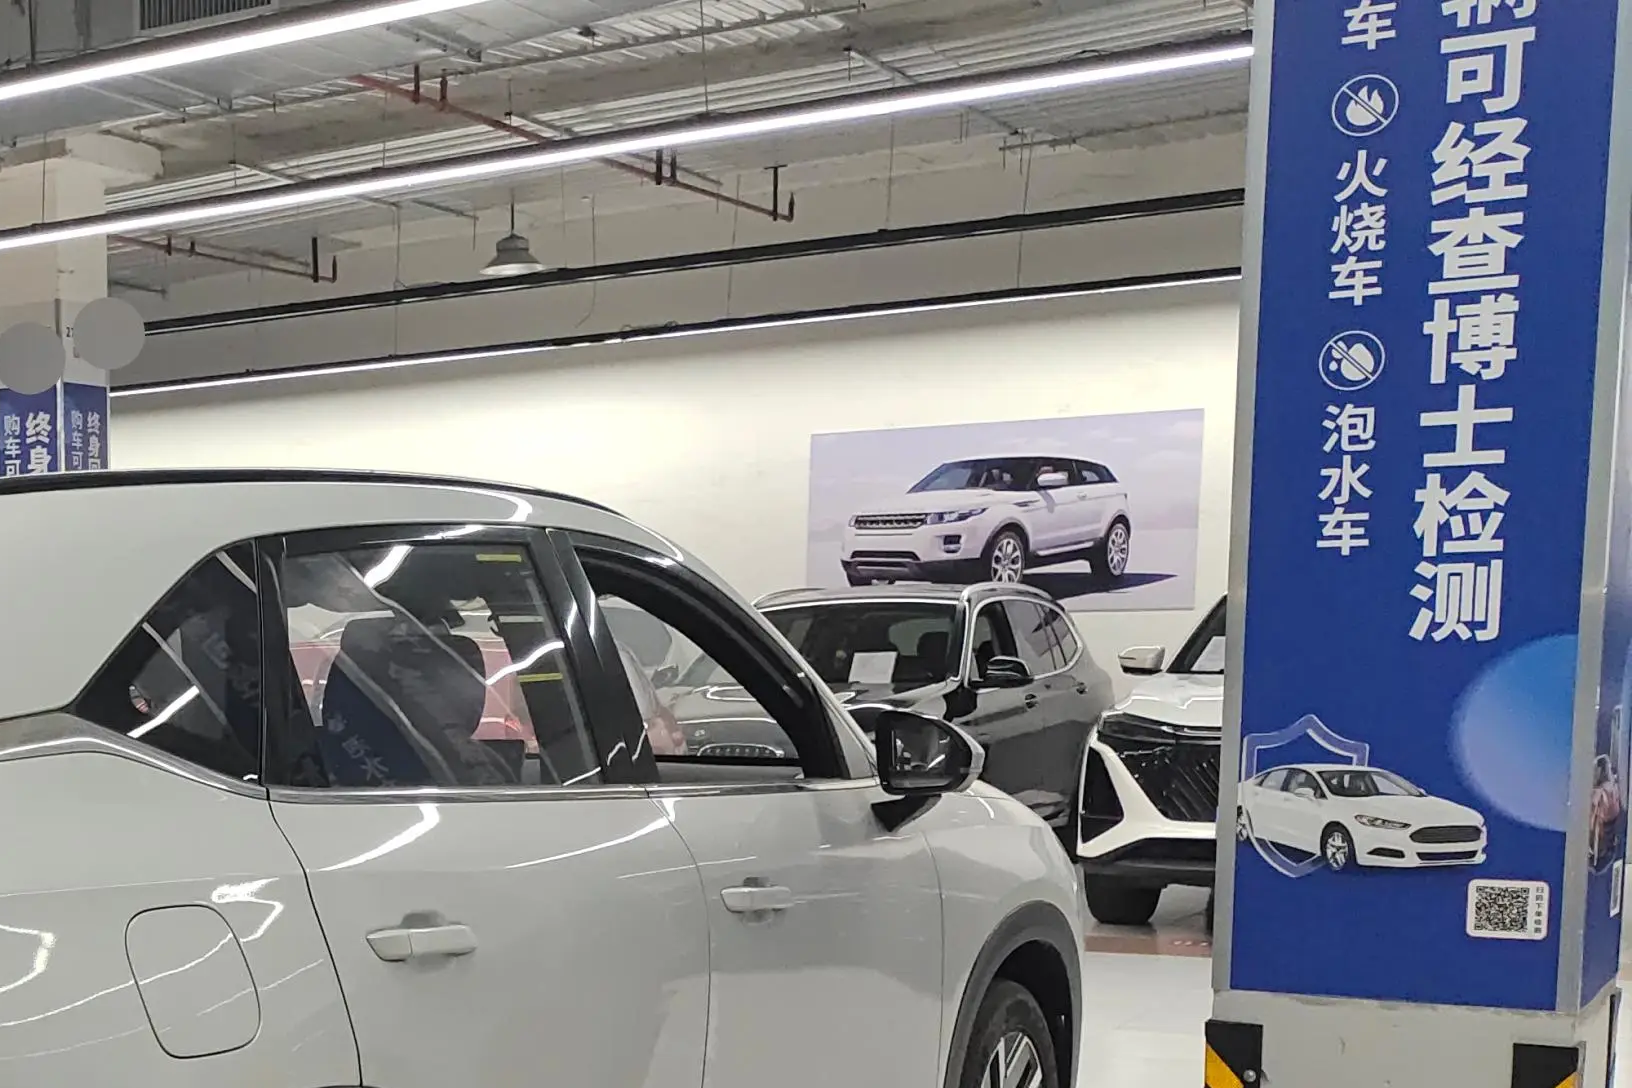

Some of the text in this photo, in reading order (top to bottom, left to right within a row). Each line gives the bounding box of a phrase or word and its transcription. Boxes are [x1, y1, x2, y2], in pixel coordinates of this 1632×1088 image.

[1317, 0, 1397, 556] 车 火烧车 泡水车
[3, 413, 22, 477] 购车可
[25, 411, 52, 475] 终身
[70, 410, 84, 470] 购车可
